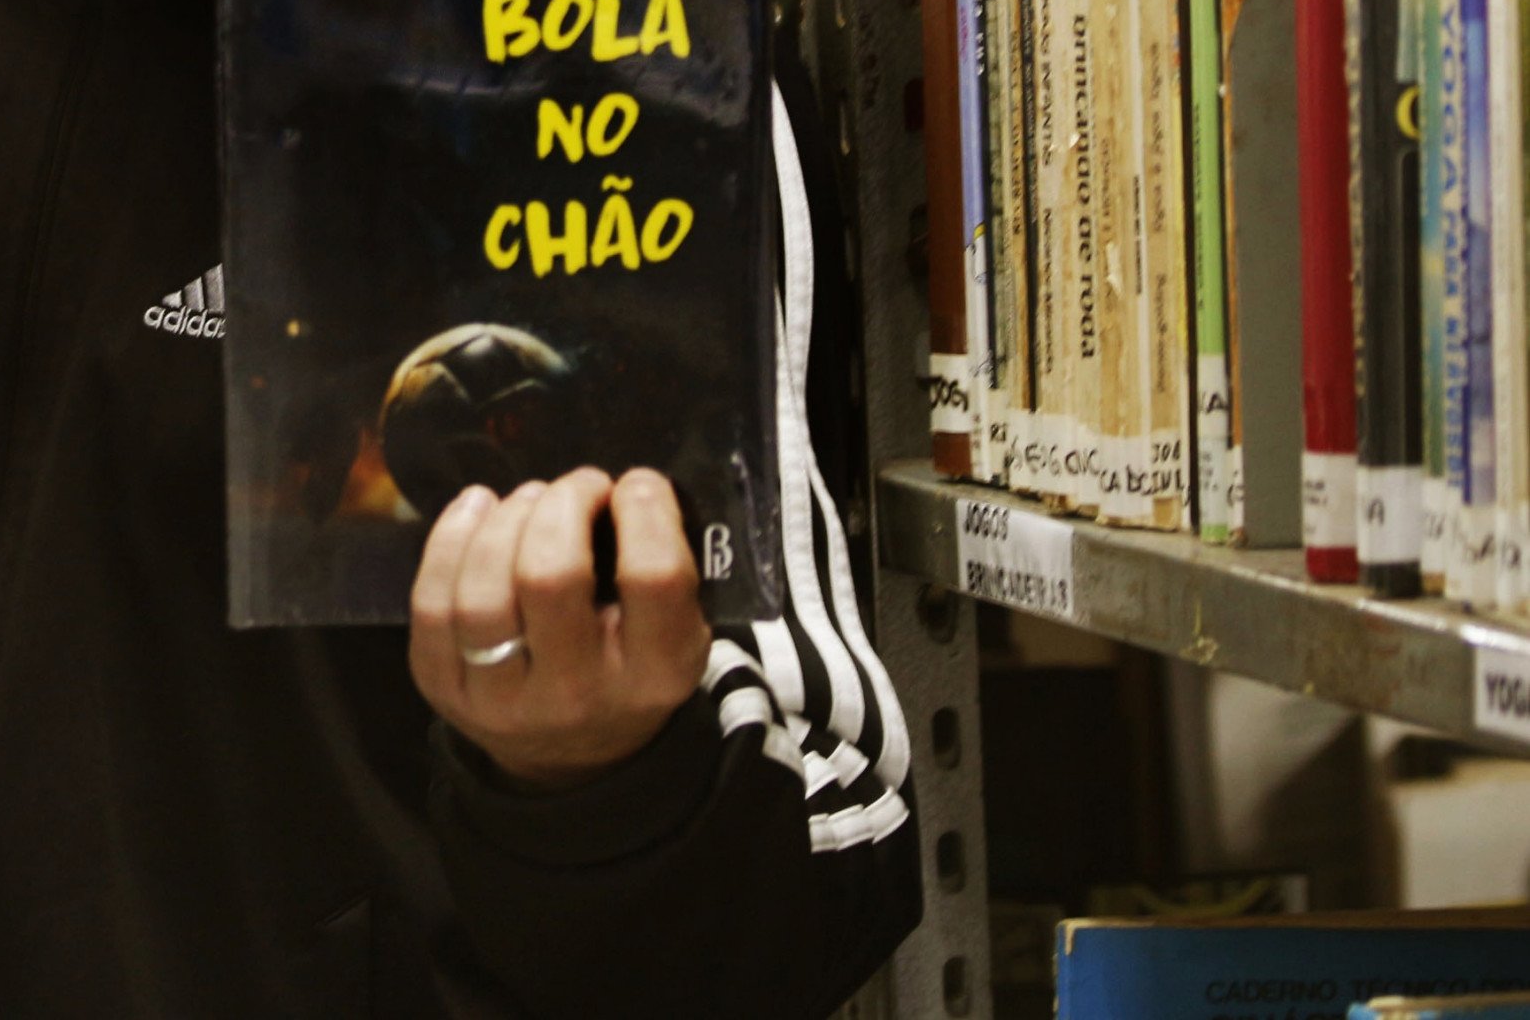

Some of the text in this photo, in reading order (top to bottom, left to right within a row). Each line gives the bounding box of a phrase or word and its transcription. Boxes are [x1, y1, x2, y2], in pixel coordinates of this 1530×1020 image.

[537, 93, 640, 163] NO
[484, 174, 694, 277] CHÃO
[1484, 672, 1530, 720] YOG
